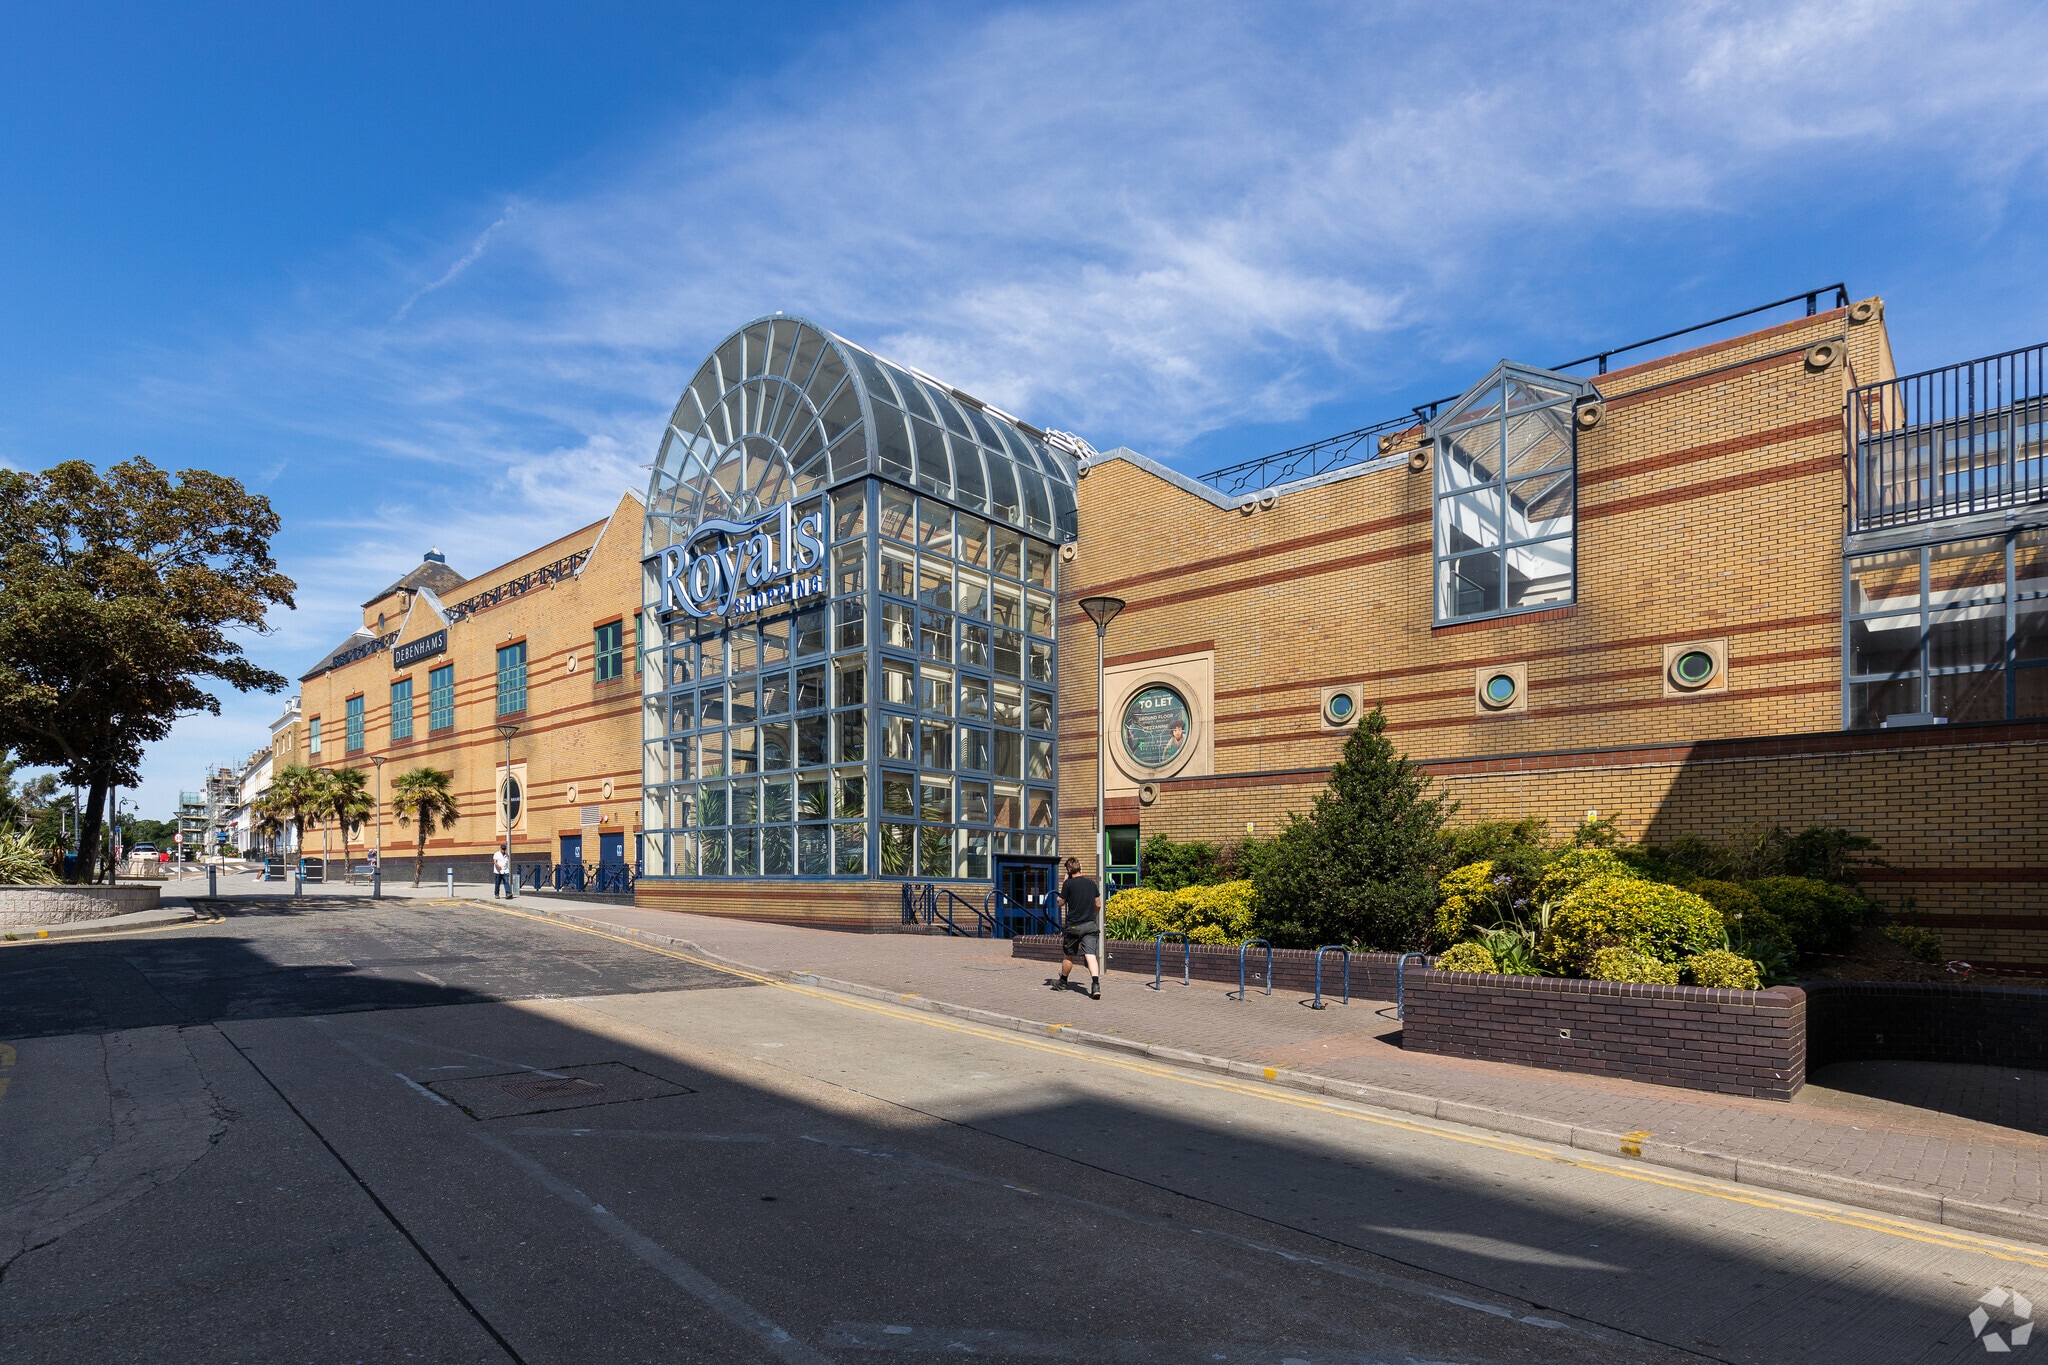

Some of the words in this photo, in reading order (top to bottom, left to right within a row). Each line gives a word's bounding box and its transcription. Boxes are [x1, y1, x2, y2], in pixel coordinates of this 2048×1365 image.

[656, 501, 825, 618] Royals
[734, 575, 823, 616] SHOPPING
[395, 634, 443, 663] DEBENHAMS
[1139, 699, 1153, 709] TO
[1154, 697, 1173, 707] LET
